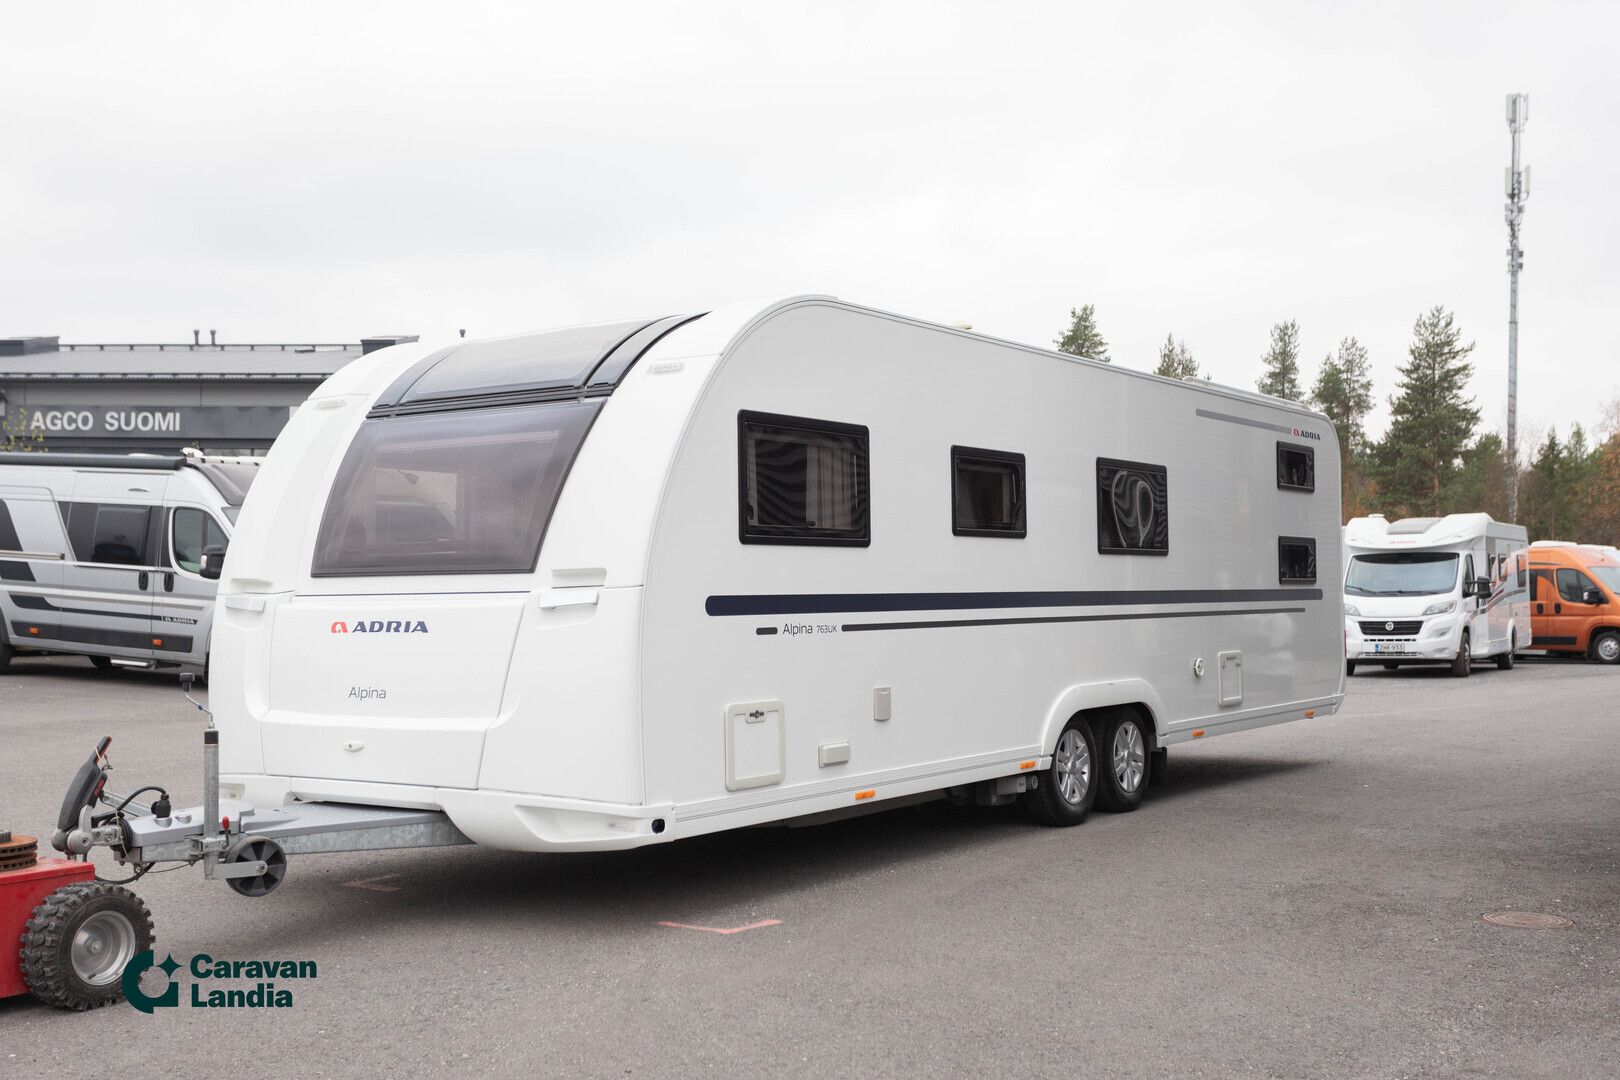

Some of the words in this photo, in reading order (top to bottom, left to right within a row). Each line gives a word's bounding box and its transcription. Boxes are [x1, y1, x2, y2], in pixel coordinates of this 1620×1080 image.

[30, 411, 94, 431] AGCO
[104, 411, 181, 431] SUOMI
[1300, 430, 1321, 441] ADRIA
[352, 620, 429, 633] ADRIA
[782, 623, 813, 636] Alpina
[816, 624, 838, 634] 763UK
[348, 686, 387, 701] Alpina
